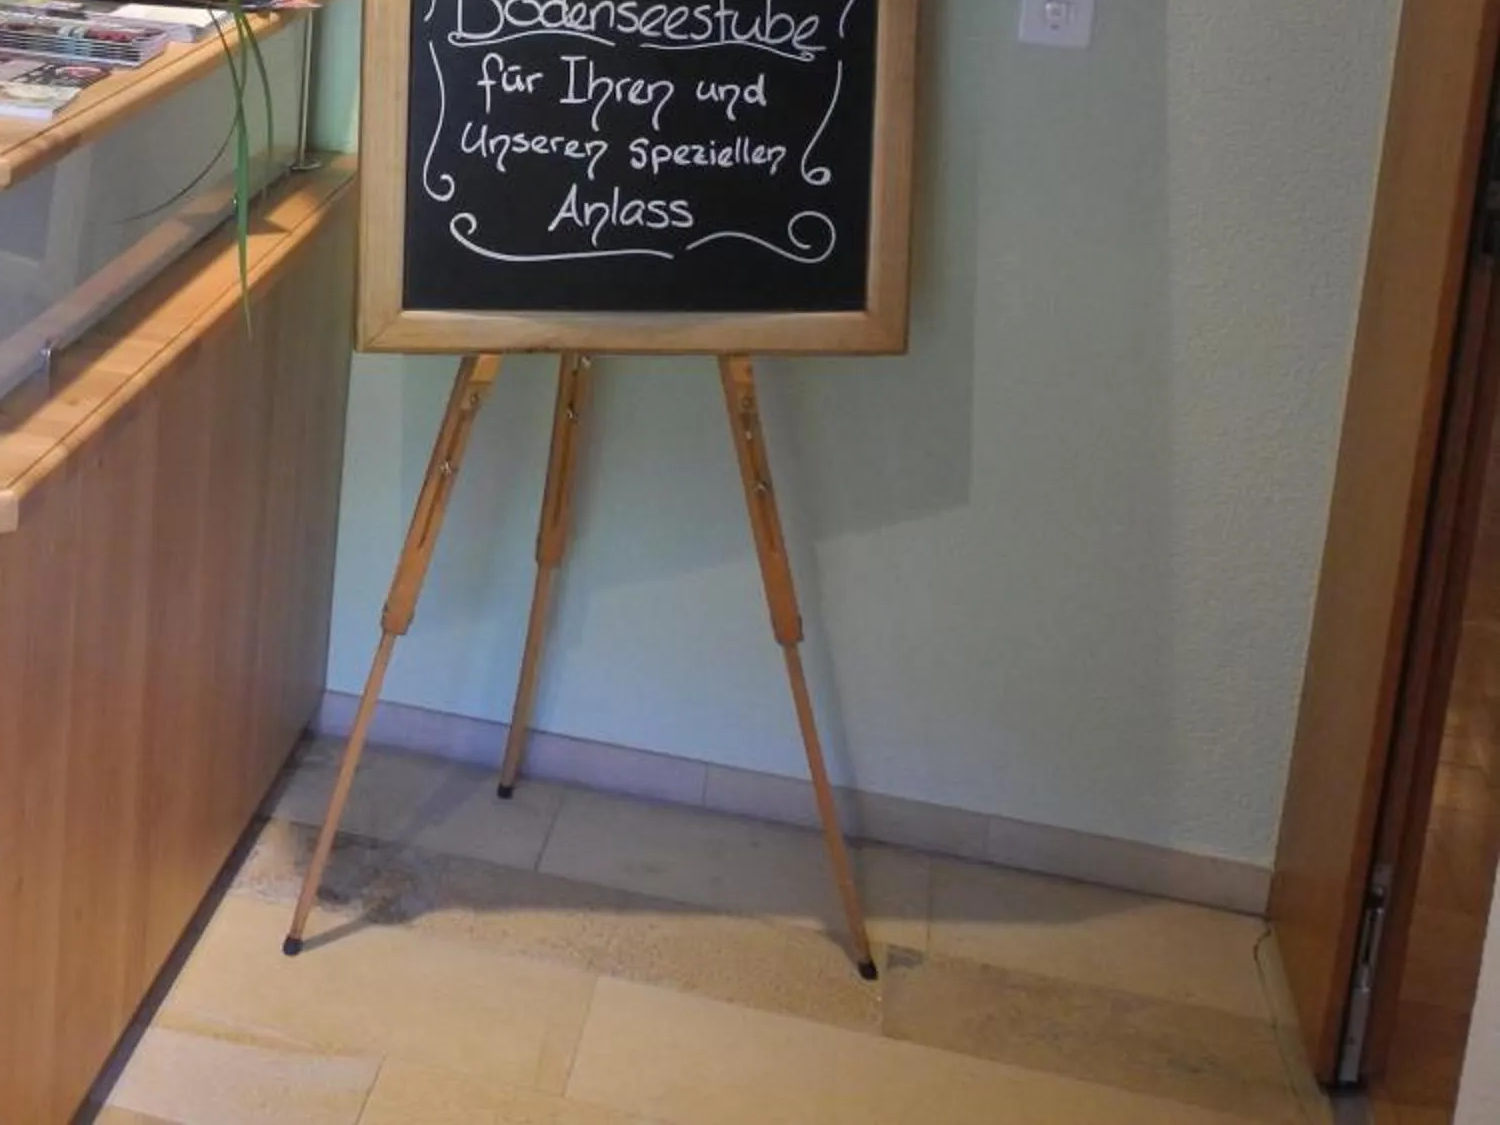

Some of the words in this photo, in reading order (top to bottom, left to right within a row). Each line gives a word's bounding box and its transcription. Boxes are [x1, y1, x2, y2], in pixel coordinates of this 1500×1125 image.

[477, 53, 543, 114] für
[560, 56, 674, 131] Ihren
[696, 75, 767, 121] und
[548, 184, 695, 247] Anlass
